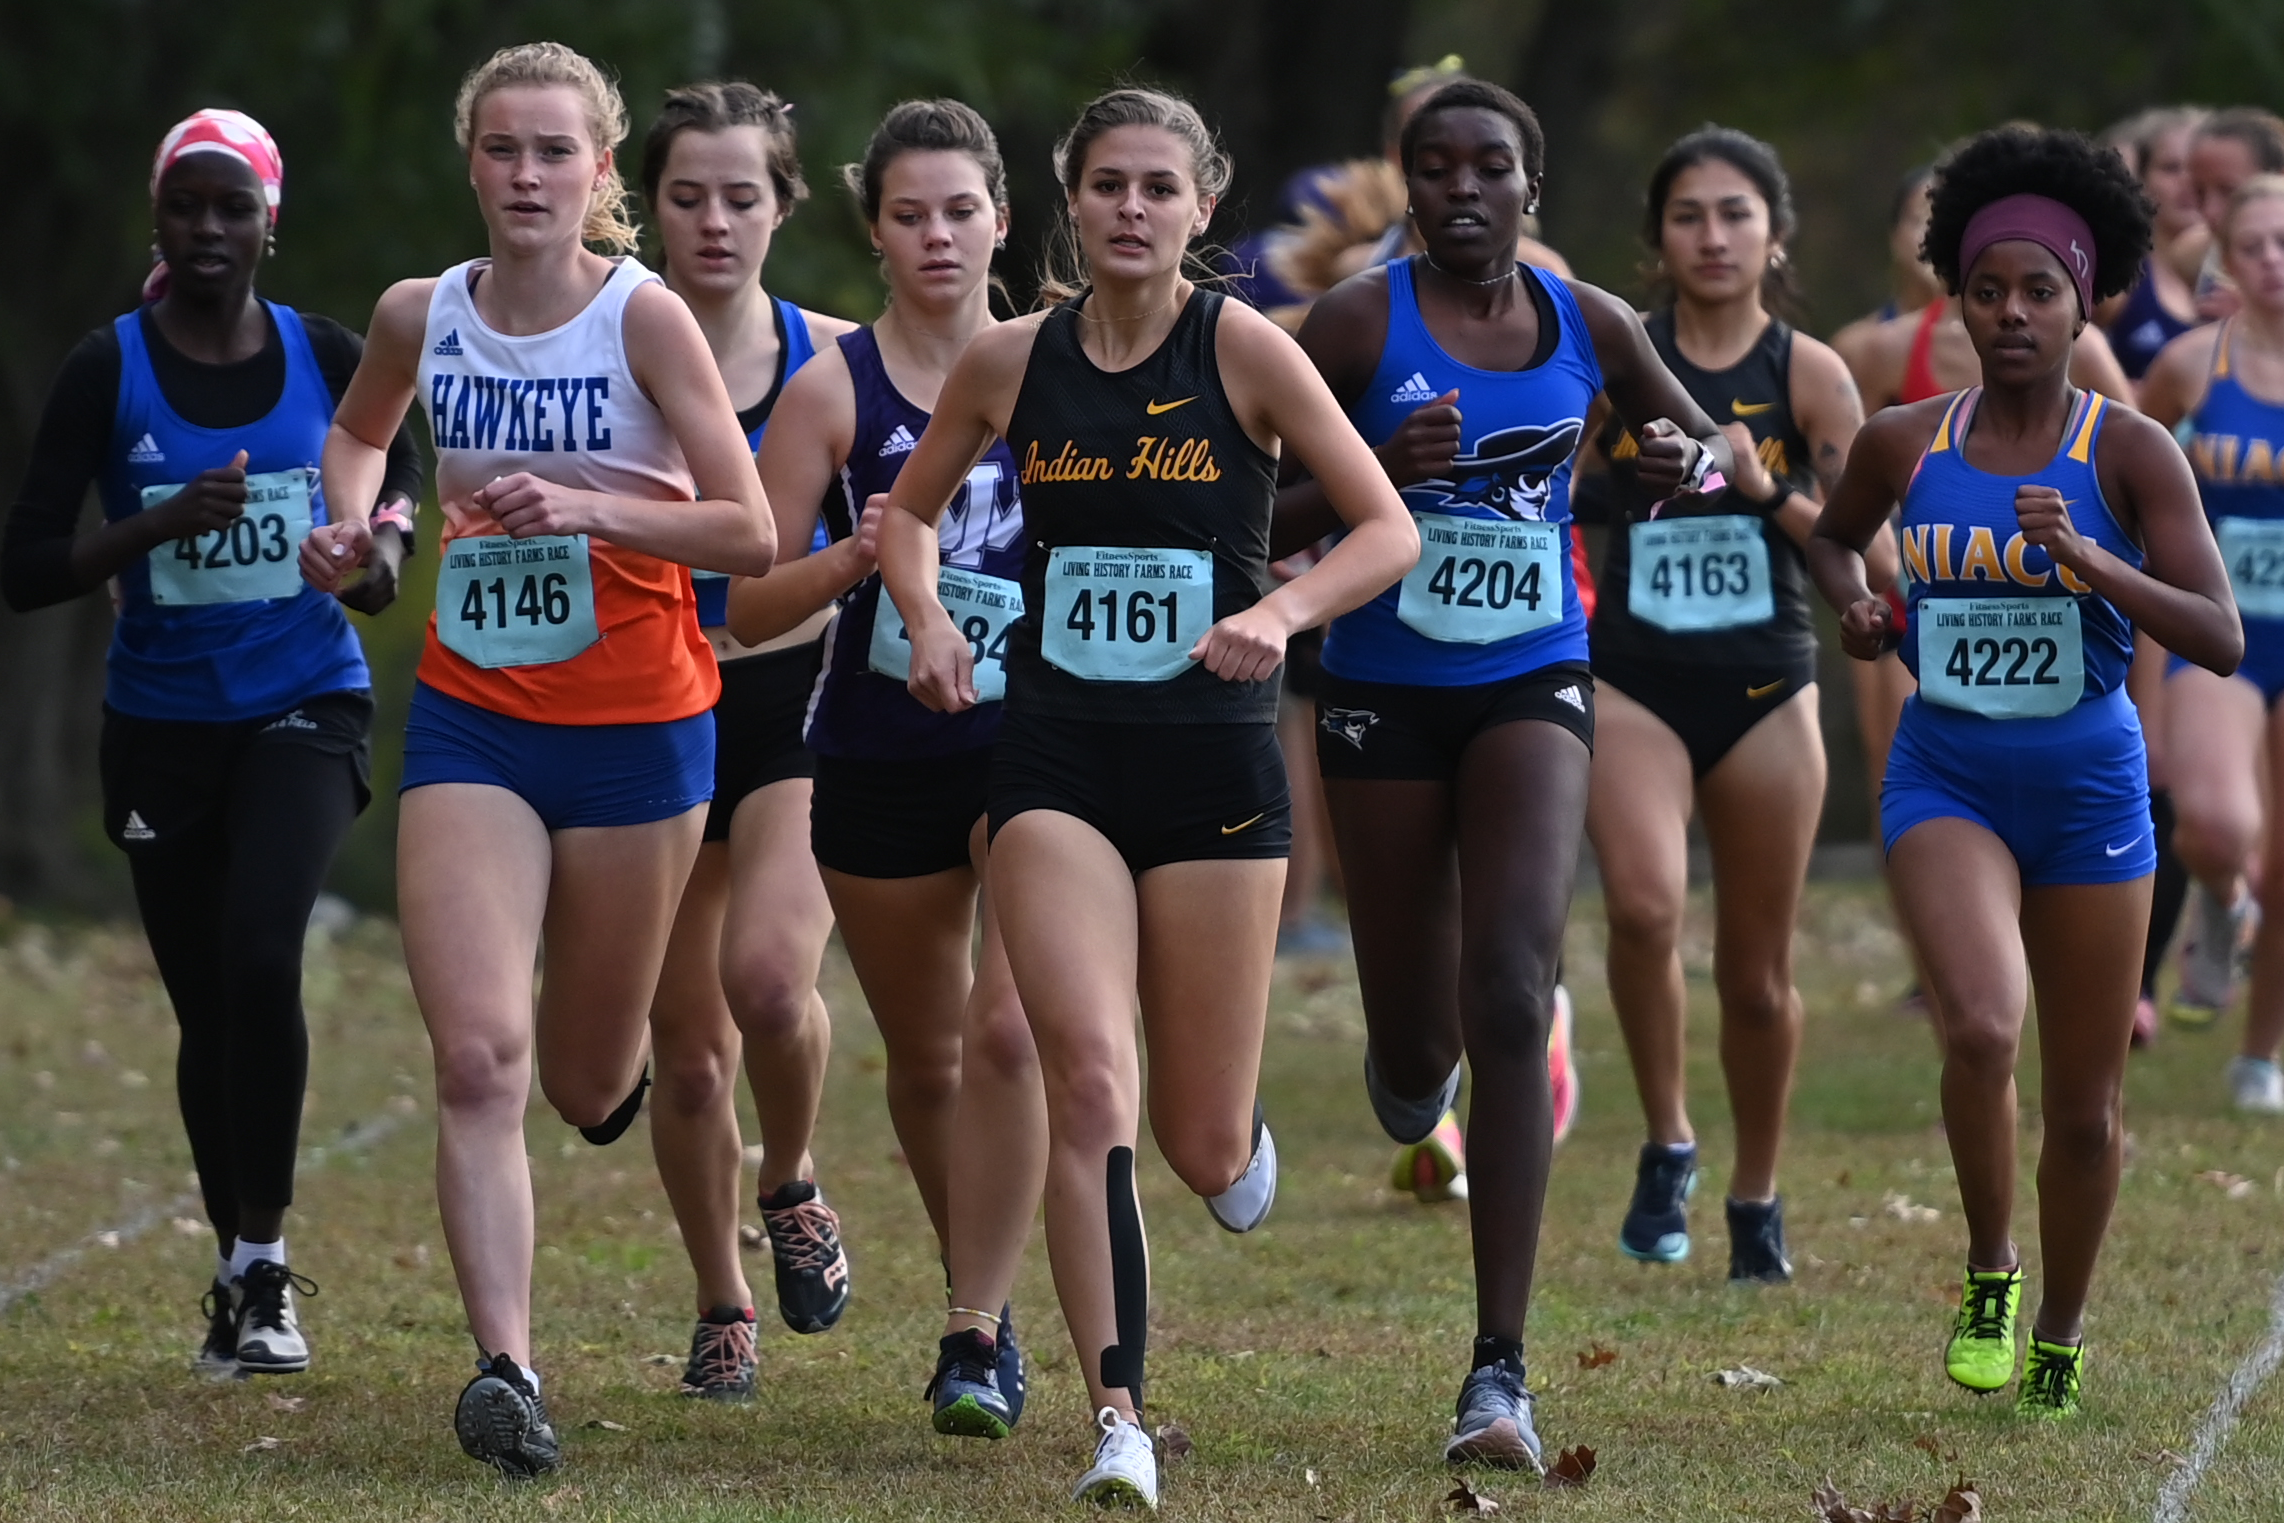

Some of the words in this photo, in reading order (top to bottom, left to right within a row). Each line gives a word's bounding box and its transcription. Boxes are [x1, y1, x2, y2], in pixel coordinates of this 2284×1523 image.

[432, 374, 611, 452] HAWKEYE
[1391, 390, 1438, 403] adidas
[878, 441, 918, 457] adida
[1021, 440, 1113, 485] Indian
[1126, 436, 1221, 482] Hills
[174, 513, 290, 570] 4203
[450, 553, 476, 569] LIVING
[479, 550, 512, 567] HISTORY
[515, 547, 545, 564] FARMS
[547, 545, 570, 561] RACE
[1427, 527, 1458, 545] LIVING
[1460, 531, 1497, 548] HISTORY
[1499, 534, 1528, 550] FARMS
[1530, 536, 1548, 550] RACE
[1062, 561, 1091, 577] LIVING
[1093, 562, 1131, 578] HISTORY
[1134, 563, 1166, 579] FARMS
[1169, 564, 1193, 580] RACE
[1428, 555, 1541, 611] 4204
[1650, 551, 1749, 598] 4163
[461, 572, 570, 631] 4146
[975, 589, 1007, 609] FARMS
[1067, 589, 1177, 643] 4161
[1937, 613, 1966, 627] LIVING
[1969, 613, 2004, 627] HISTORY
[2007, 612, 2037, 626] FARMS
[2040, 612, 2063, 626] RACE
[1945, 637, 2060, 686] 4222
